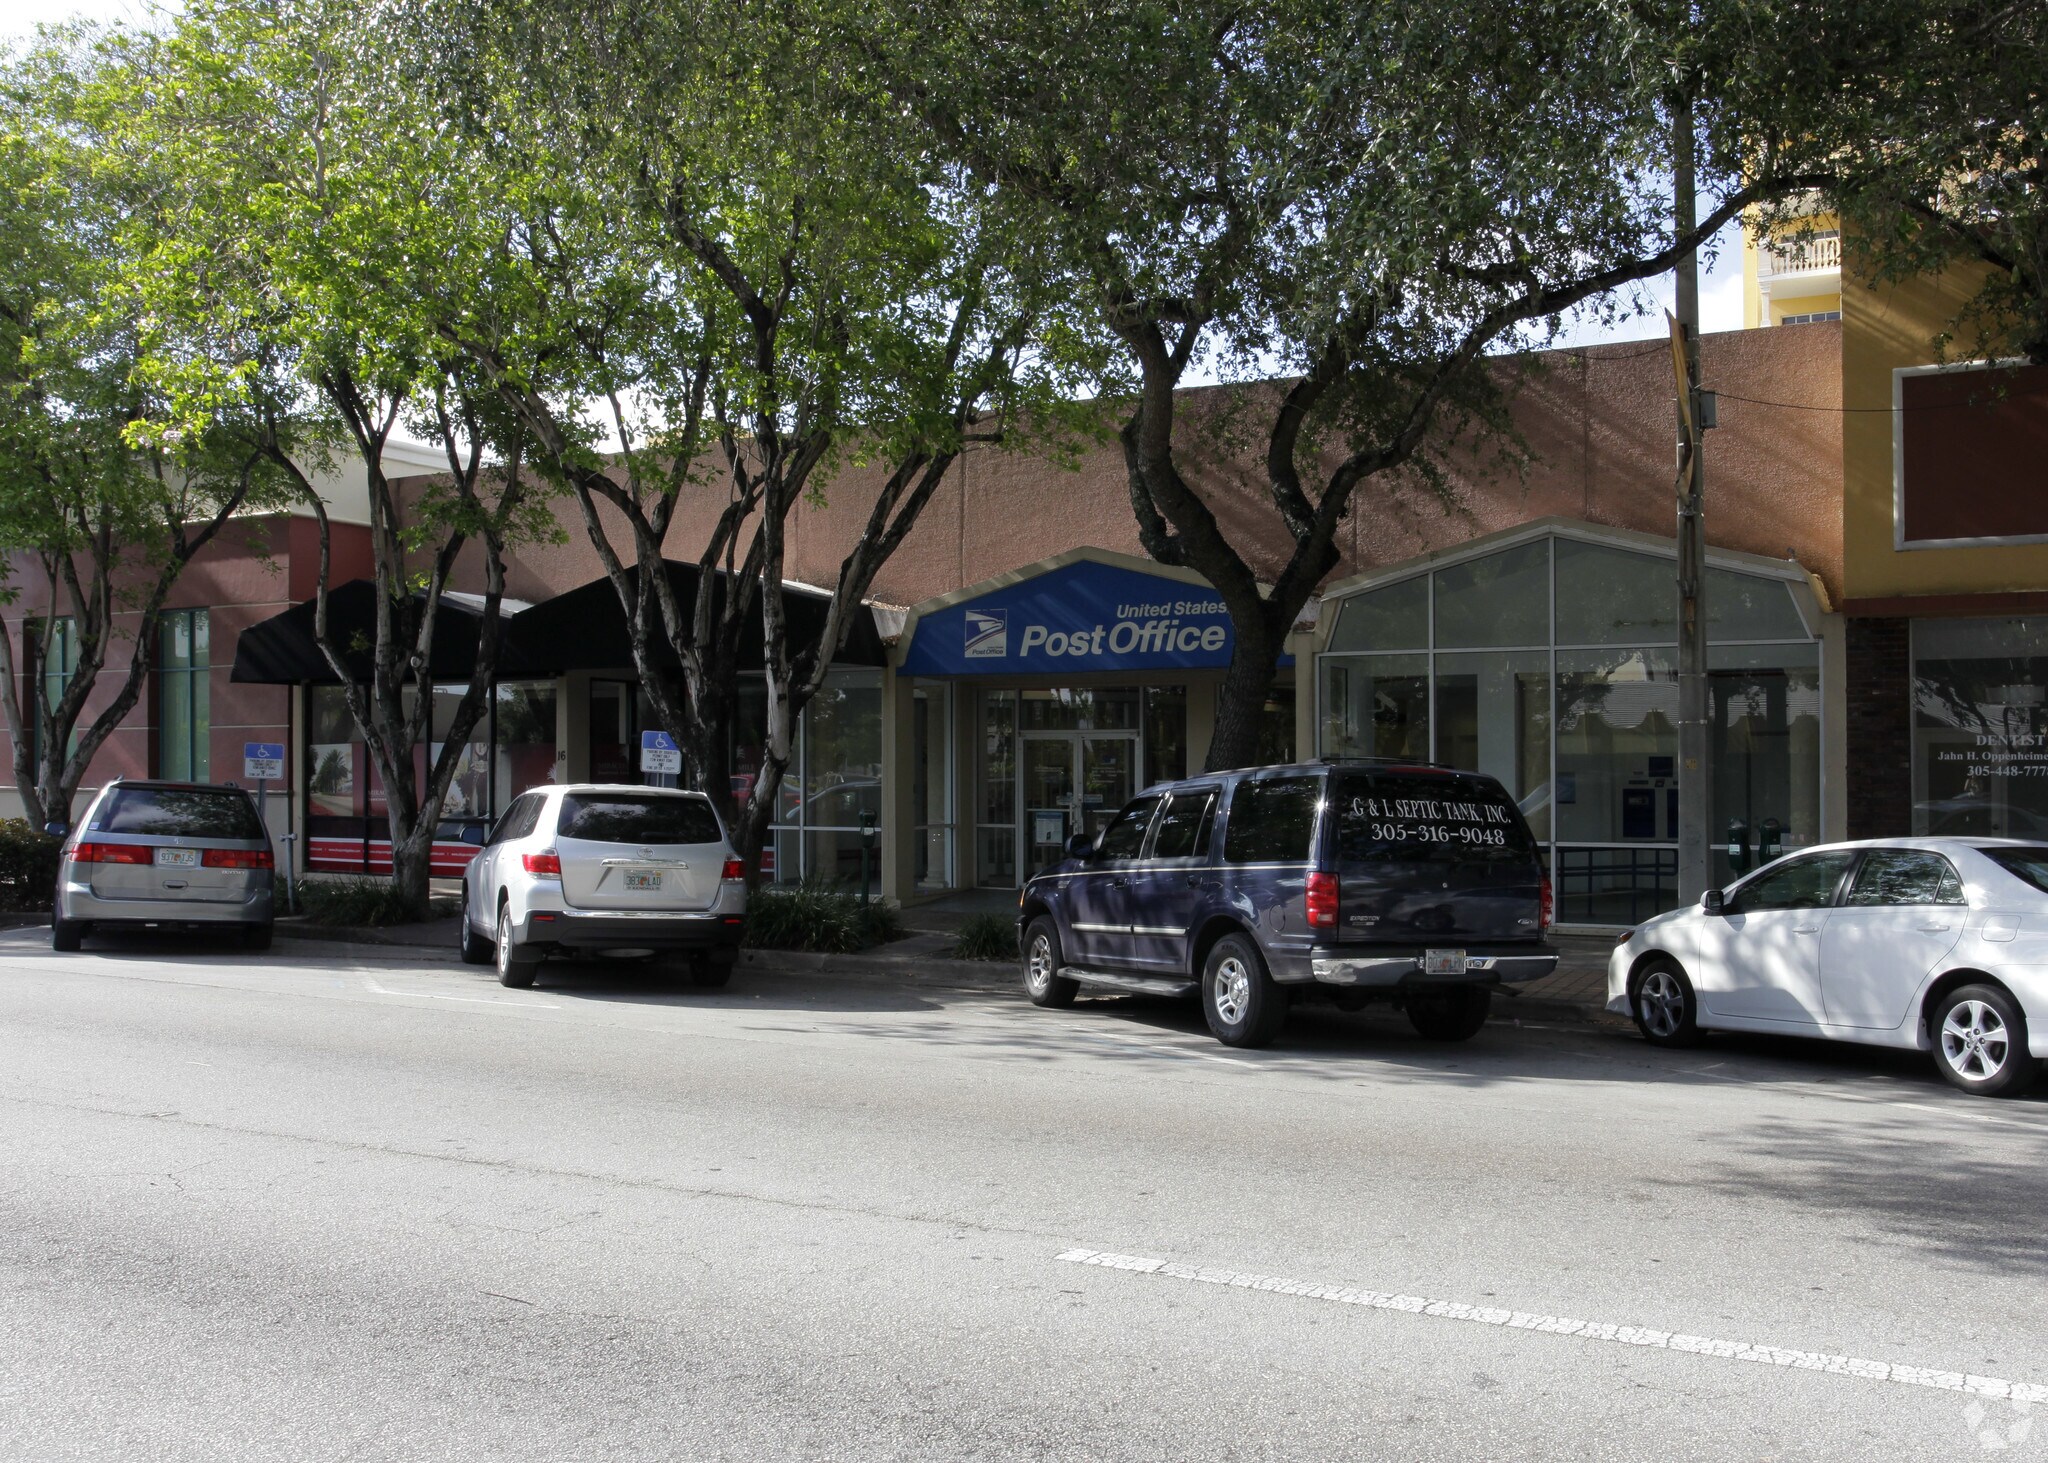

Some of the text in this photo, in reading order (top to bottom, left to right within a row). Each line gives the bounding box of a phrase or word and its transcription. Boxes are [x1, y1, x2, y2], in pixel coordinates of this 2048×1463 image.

[1116, 601, 1228, 619] United States
[1019, 619, 1227, 657] Post Office
[1975, 734, 2046, 746] DENTIST
[1966, 751, 1980, 761] H.
[1967, 765, 2048, 777] 305-448-777
[1353, 797, 1512, 826] G & L SEPTIC TANK, INC.
[1371, 822, 1506, 846] 305-316-9048
